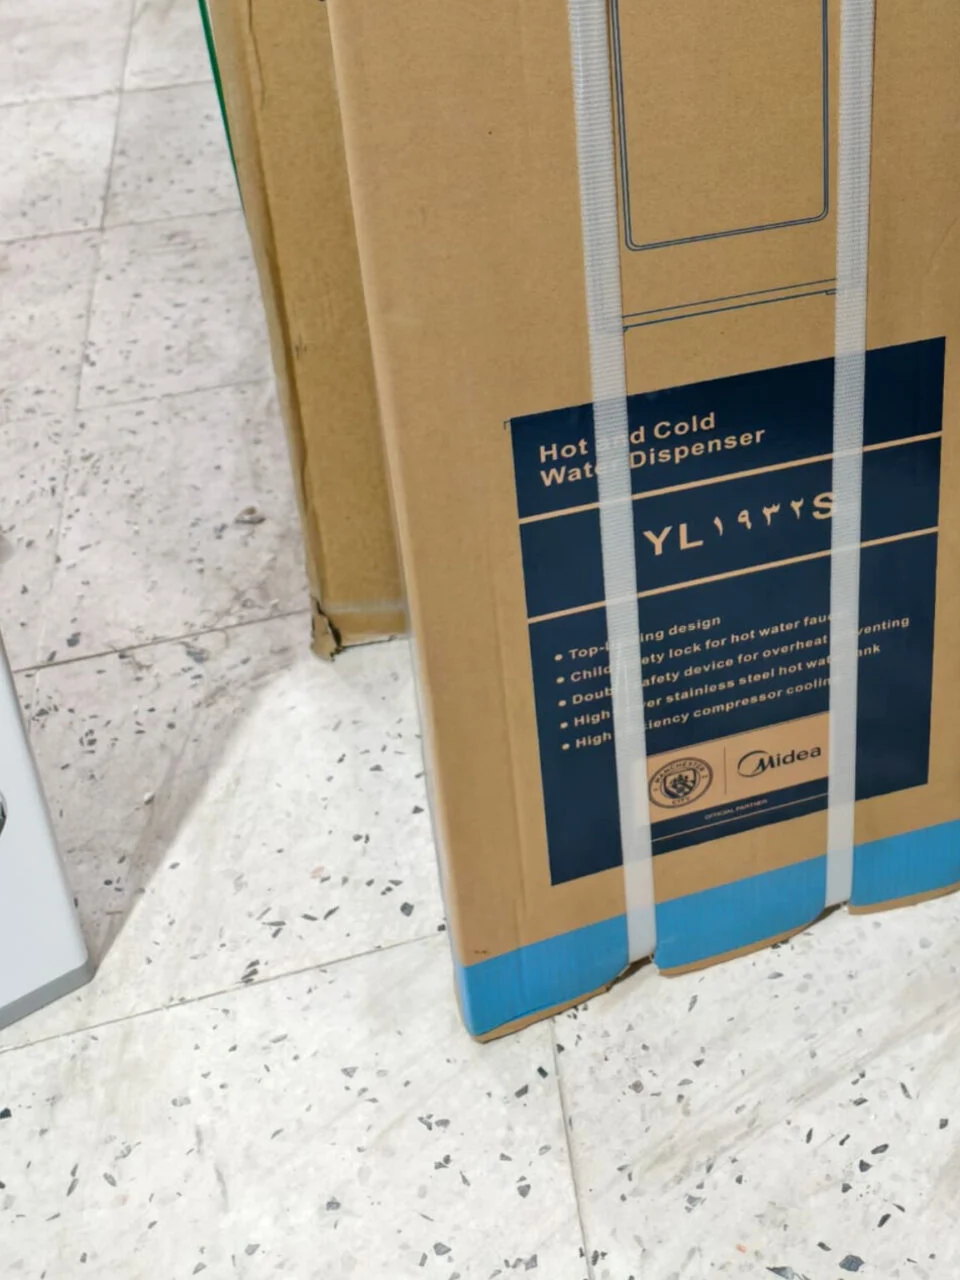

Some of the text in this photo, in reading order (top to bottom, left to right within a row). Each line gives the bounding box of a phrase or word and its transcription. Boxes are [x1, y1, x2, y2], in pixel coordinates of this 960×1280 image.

[539, 437, 589, 464] Hot
[653, 411, 716, 439] Cold
[628, 428, 766, 469] Dispenser
[668, 616, 721, 637] design
[669, 642, 702, 659] lock
[705, 637, 727, 651] for
[731, 629, 755, 644] hot
[758, 620, 800, 637] water
[642, 670, 680, 690] afety
[684, 658, 734, 678] device
[737, 651, 758, 664] for
[762, 634, 828, 659] overheat
[573, 709, 610, 728] High
[665, 679, 735, 704] stainless
[739, 667, 775, 686] steel
[778, 662, 803, 677] hot
[575, 730, 612, 749] High
[693, 688, 783, 719] compressor
[786, 676, 832, 696] coolin
[737, 745, 823, 778] Midea
